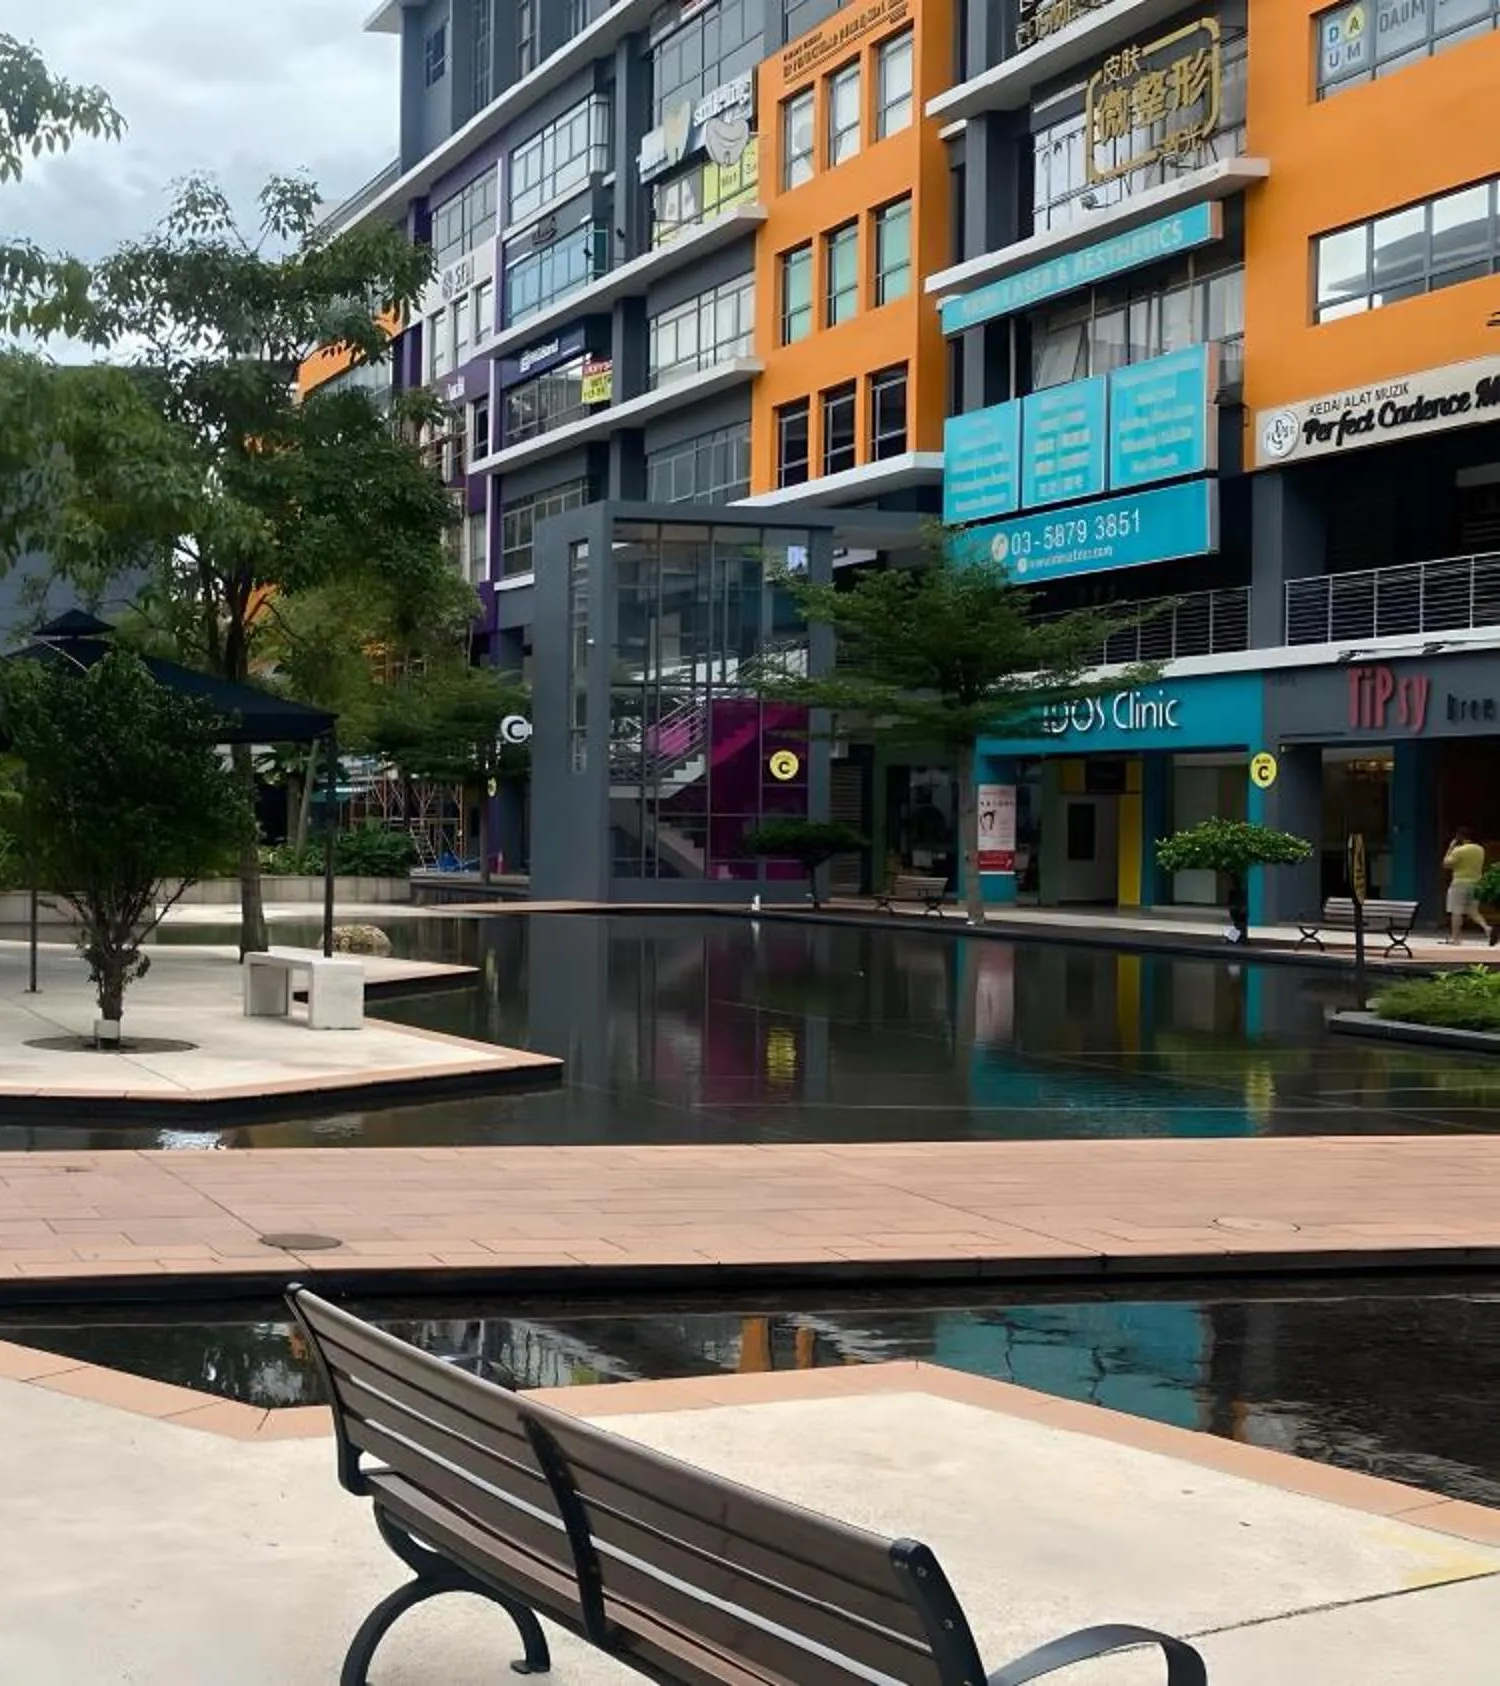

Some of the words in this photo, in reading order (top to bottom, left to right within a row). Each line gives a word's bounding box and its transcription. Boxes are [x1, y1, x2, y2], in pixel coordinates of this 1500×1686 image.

[1097, 48, 1210, 143] 微整形
[1309, 399, 1342, 417] KEDAI
[1343, 391, 1373, 410] ALAT
[1374, 381, 1411, 402] MUZIK
[1302, 408, 1375, 447] Perfect
[1377, 391, 1472, 429] Cadence
[1094, 507, 1140, 541] 3851
[1113, 689, 1181, 730] Clinic
[507, 719, 525, 740] C
[1257, 765, 1269, 781] C
